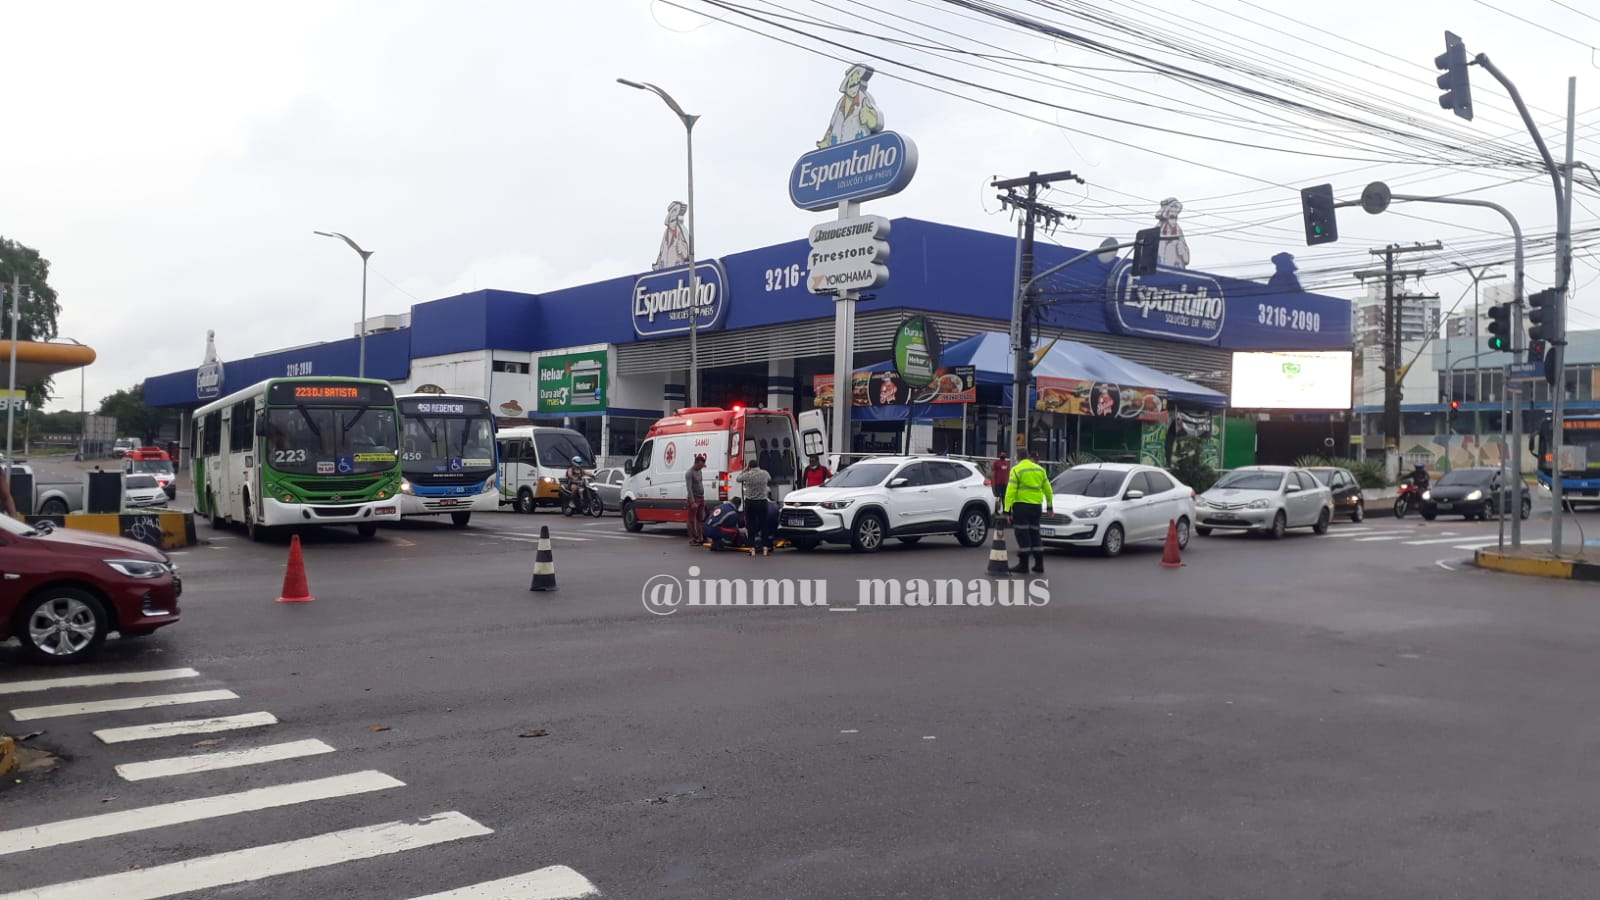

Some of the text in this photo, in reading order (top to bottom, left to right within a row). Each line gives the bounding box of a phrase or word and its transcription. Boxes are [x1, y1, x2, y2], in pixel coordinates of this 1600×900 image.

[799, 143, 896, 190] Espantalho
[837, 168, 892, 189] SOLUÇÕES EM PNEUS
[813, 221, 874, 243] BRIDGESTONE
[812, 245, 874, 266] Firestone
[765, 263, 810, 292] 3216-
[825, 269, 872, 286] YOKOHAMA
[1123, 273, 1221, 320] Espantalho
[1258, 303, 1321, 333] 3216-2090
[541, 367, 565, 381] Heliar
[295, 387, 312, 398] 223
[0, 399, 22, 411] BR
[695, 438, 710, 447] SAMU
[275, 449, 306, 463] 223
[402, 452, 422, 461] 450
